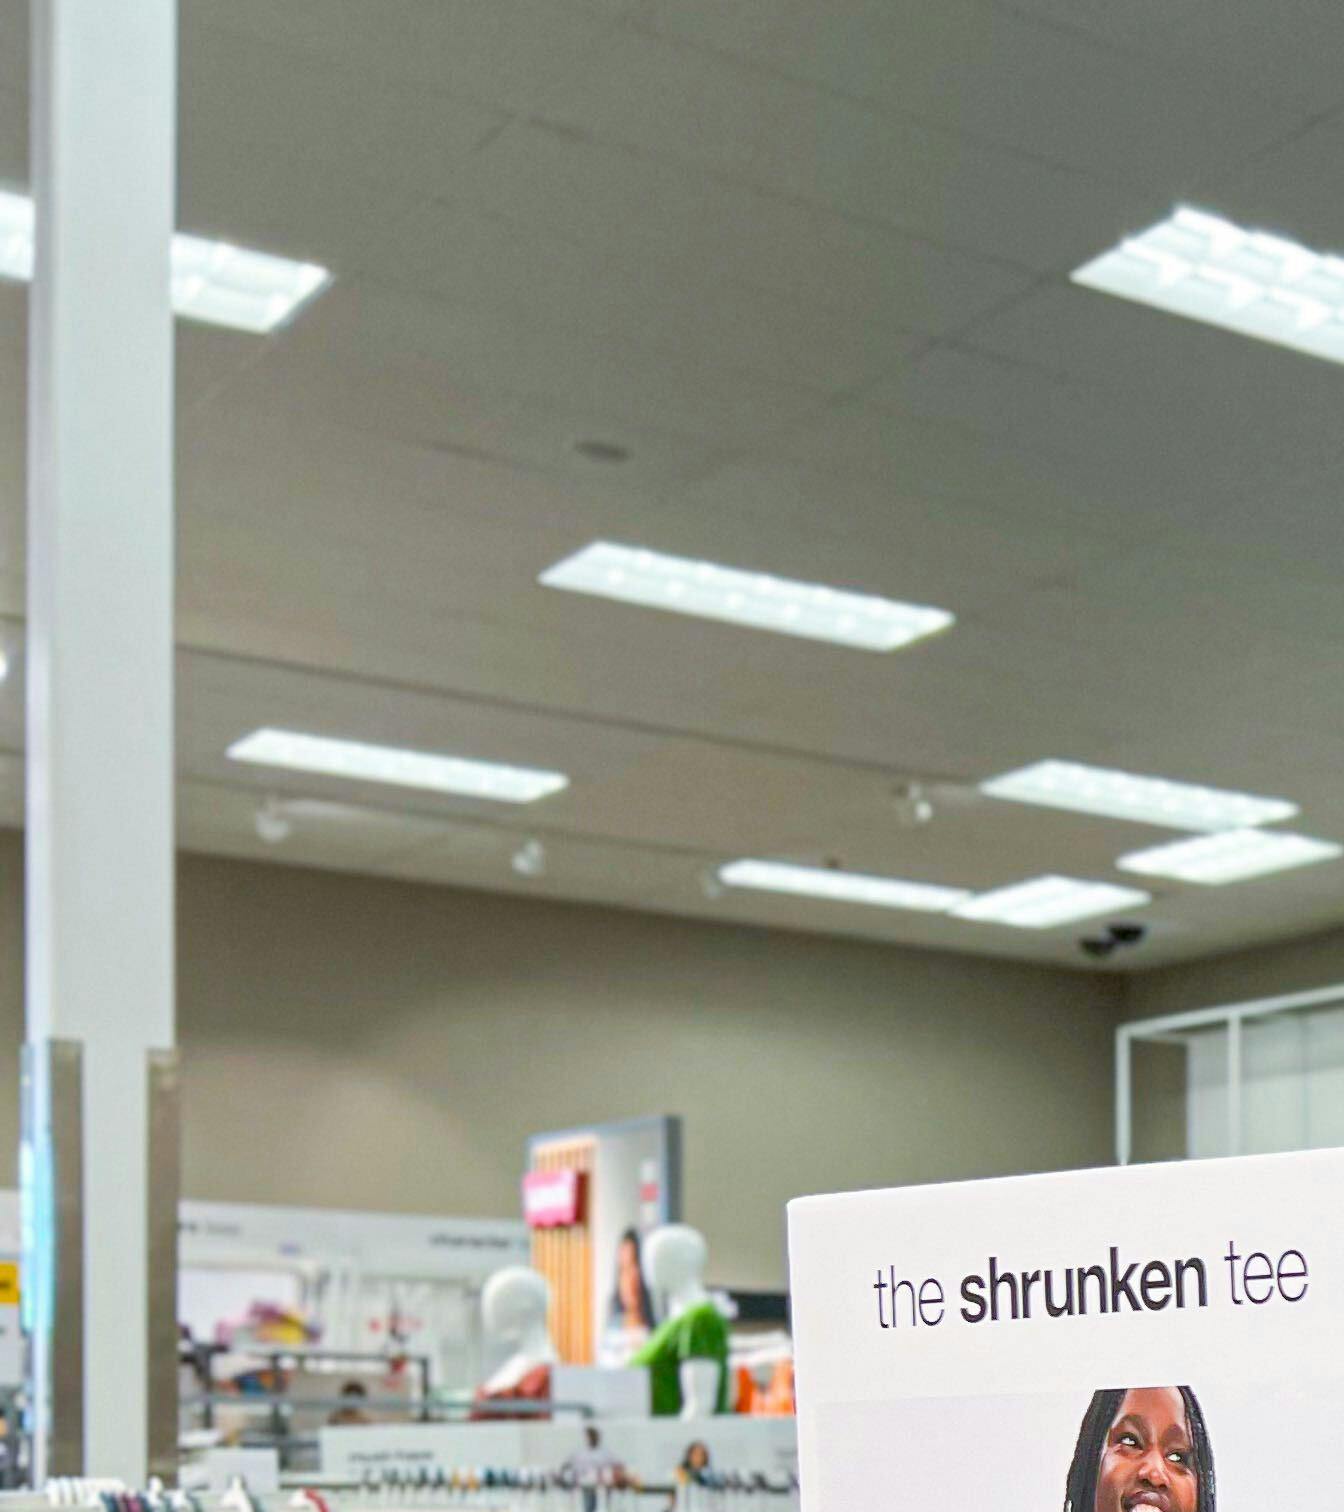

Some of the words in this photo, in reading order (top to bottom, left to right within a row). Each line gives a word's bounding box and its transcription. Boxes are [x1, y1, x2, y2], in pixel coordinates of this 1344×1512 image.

[873, 1265, 945, 1329] the
[960, 1246, 1209, 1324] shrunken
[1223, 1240, 1310, 1305] tee
